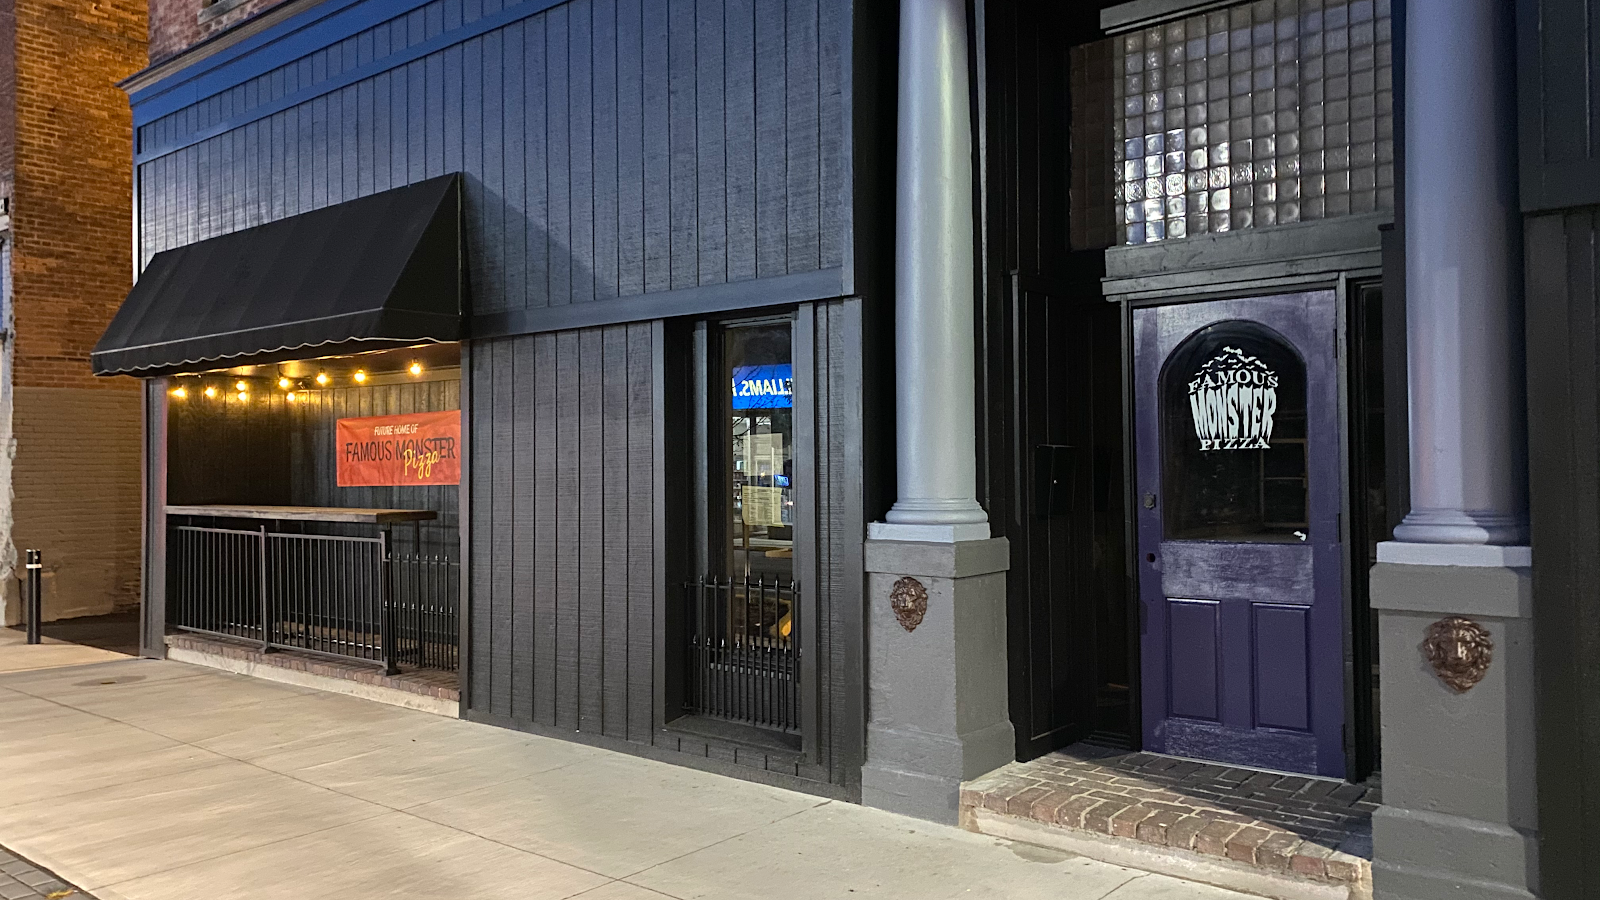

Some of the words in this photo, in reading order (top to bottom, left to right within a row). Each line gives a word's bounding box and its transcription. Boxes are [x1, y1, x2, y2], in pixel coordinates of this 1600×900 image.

[1188, 369, 1278, 394] FAMOUS
[1189, 383, 1277, 444] MONSTER
[374, 425, 393, 436] FUTURE
[394, 424, 410, 435] HOME
[410, 423, 419, 434] OF
[345, 440, 392, 462] FAMOUS
[395, 437, 456, 461] MONSTER
[1199, 437, 1271, 451] PIZZA
[403, 448, 441, 480] Pizza
